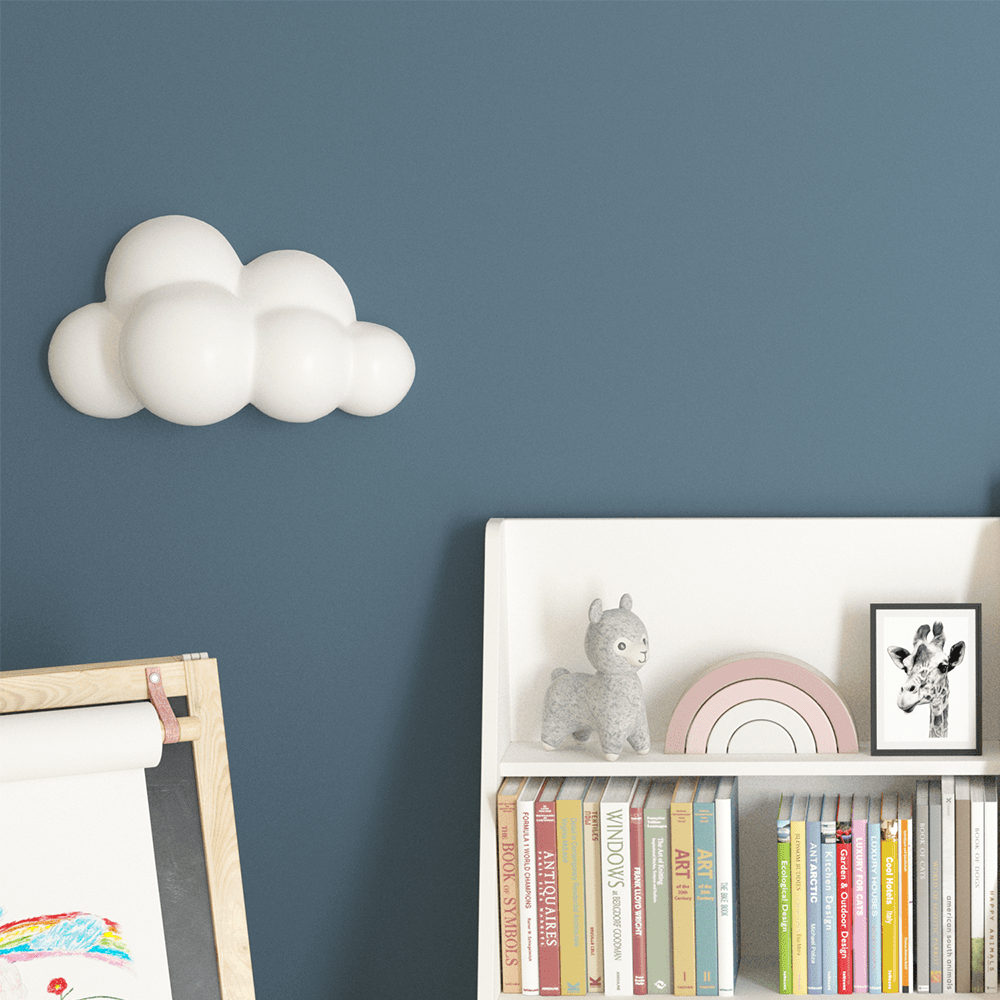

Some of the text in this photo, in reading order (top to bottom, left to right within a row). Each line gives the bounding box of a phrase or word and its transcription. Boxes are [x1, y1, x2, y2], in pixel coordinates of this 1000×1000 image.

[502, 843, 515, 882] BOOK
[606, 809, 625, 888] WINDOWS
[675, 849, 690, 879] ART
[697, 849, 713, 879] ART
[840, 849, 848, 880] Garden
[855, 837, 863, 874] LUXURY
[870, 836, 878, 875] LUXURY
[919, 848, 925, 859] OF
[974, 853, 980, 864] OF
[633, 867, 641, 888] FRANK
[809, 842, 817, 903] ANTARCTIC
[543, 851, 557, 946] ANTIQUAIRES
[634, 889, 642, 910] LLOYD
[720, 882, 728, 916] THE BIKE BOOK
[824, 851, 833, 931] Kitchen Design
[885, 857, 894, 924] Cool Hotels Italy
[933, 891, 938, 901] OF
[612, 896, 621, 928] BERGDORF
[781, 904, 789, 932] Design
[840, 892, 848, 928] Outdoor
[503, 898, 518, 966] SYMBOLS
[613, 929, 622, 961] GOODMAN
[839, 931, 849, 959] Design
